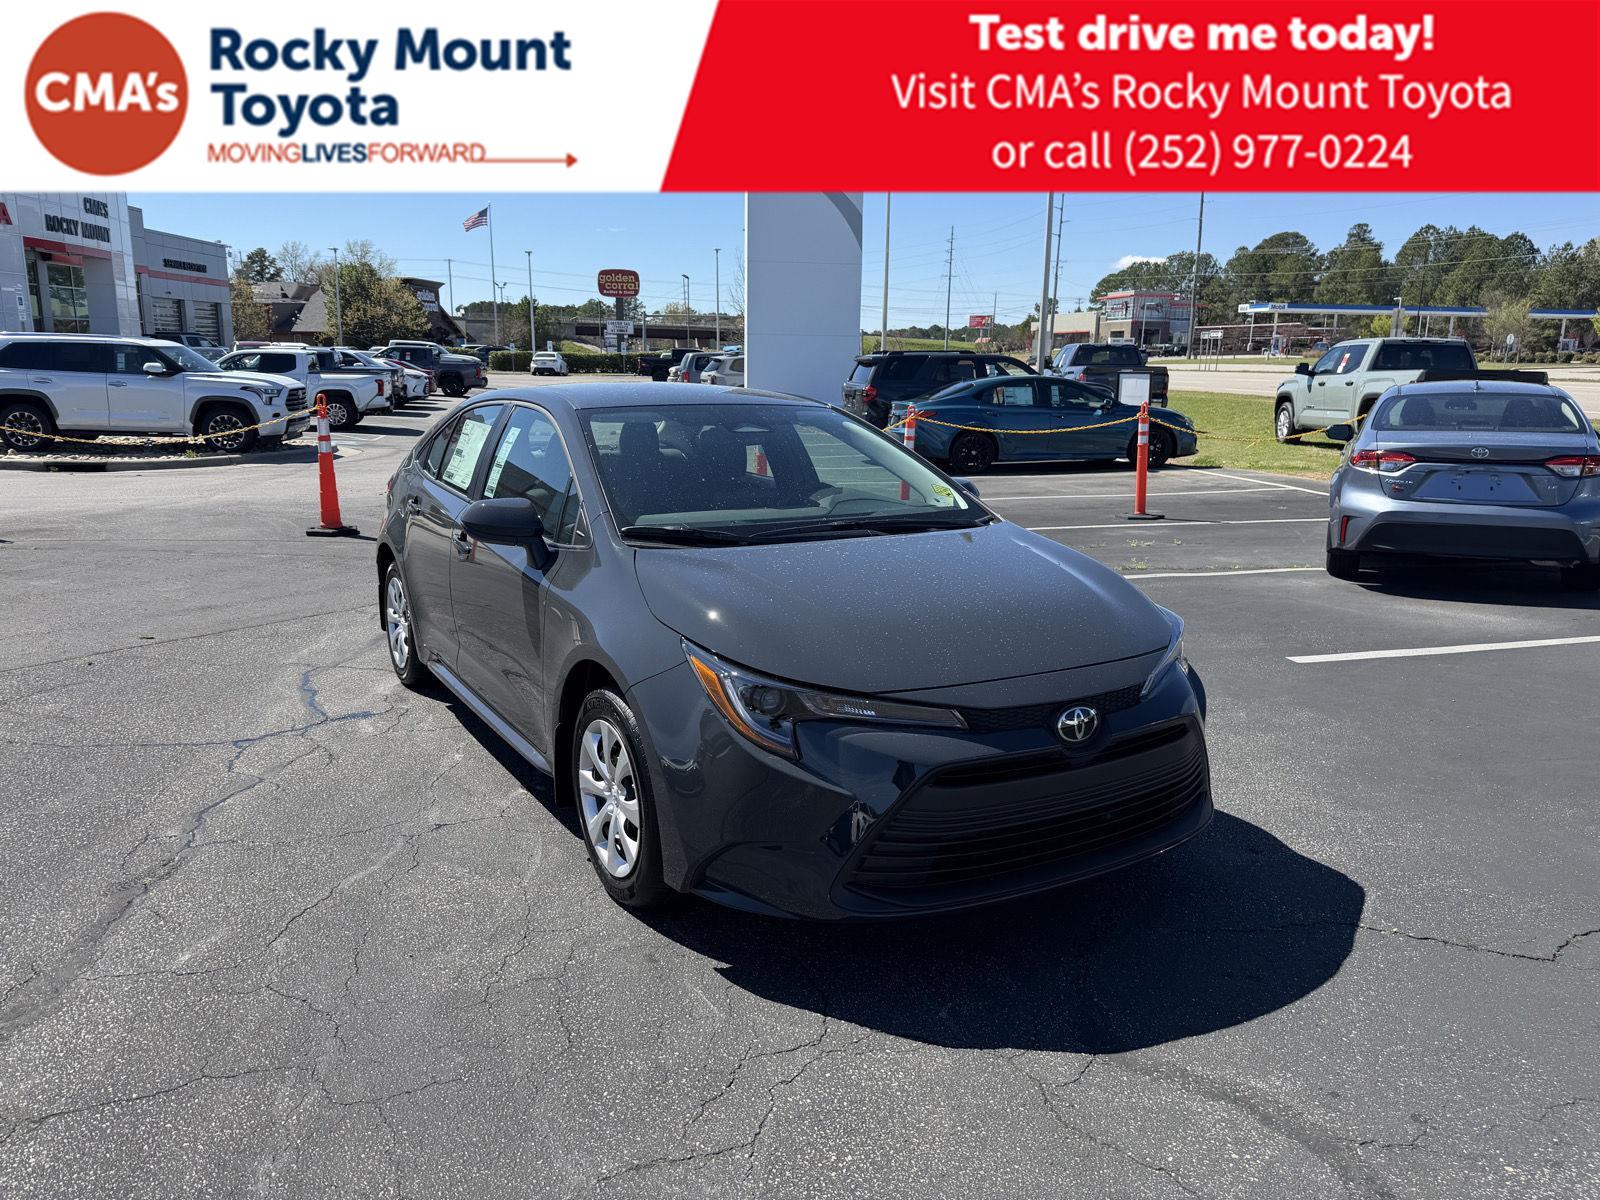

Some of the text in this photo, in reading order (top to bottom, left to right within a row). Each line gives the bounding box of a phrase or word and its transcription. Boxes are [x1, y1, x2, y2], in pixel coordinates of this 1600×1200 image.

[44, 213, 111, 243] ROCKY MOUNT
[599, 273, 635, 284] golden
[605, 281, 639, 290] corral
[1271, 303, 1286, 311] Mobil
